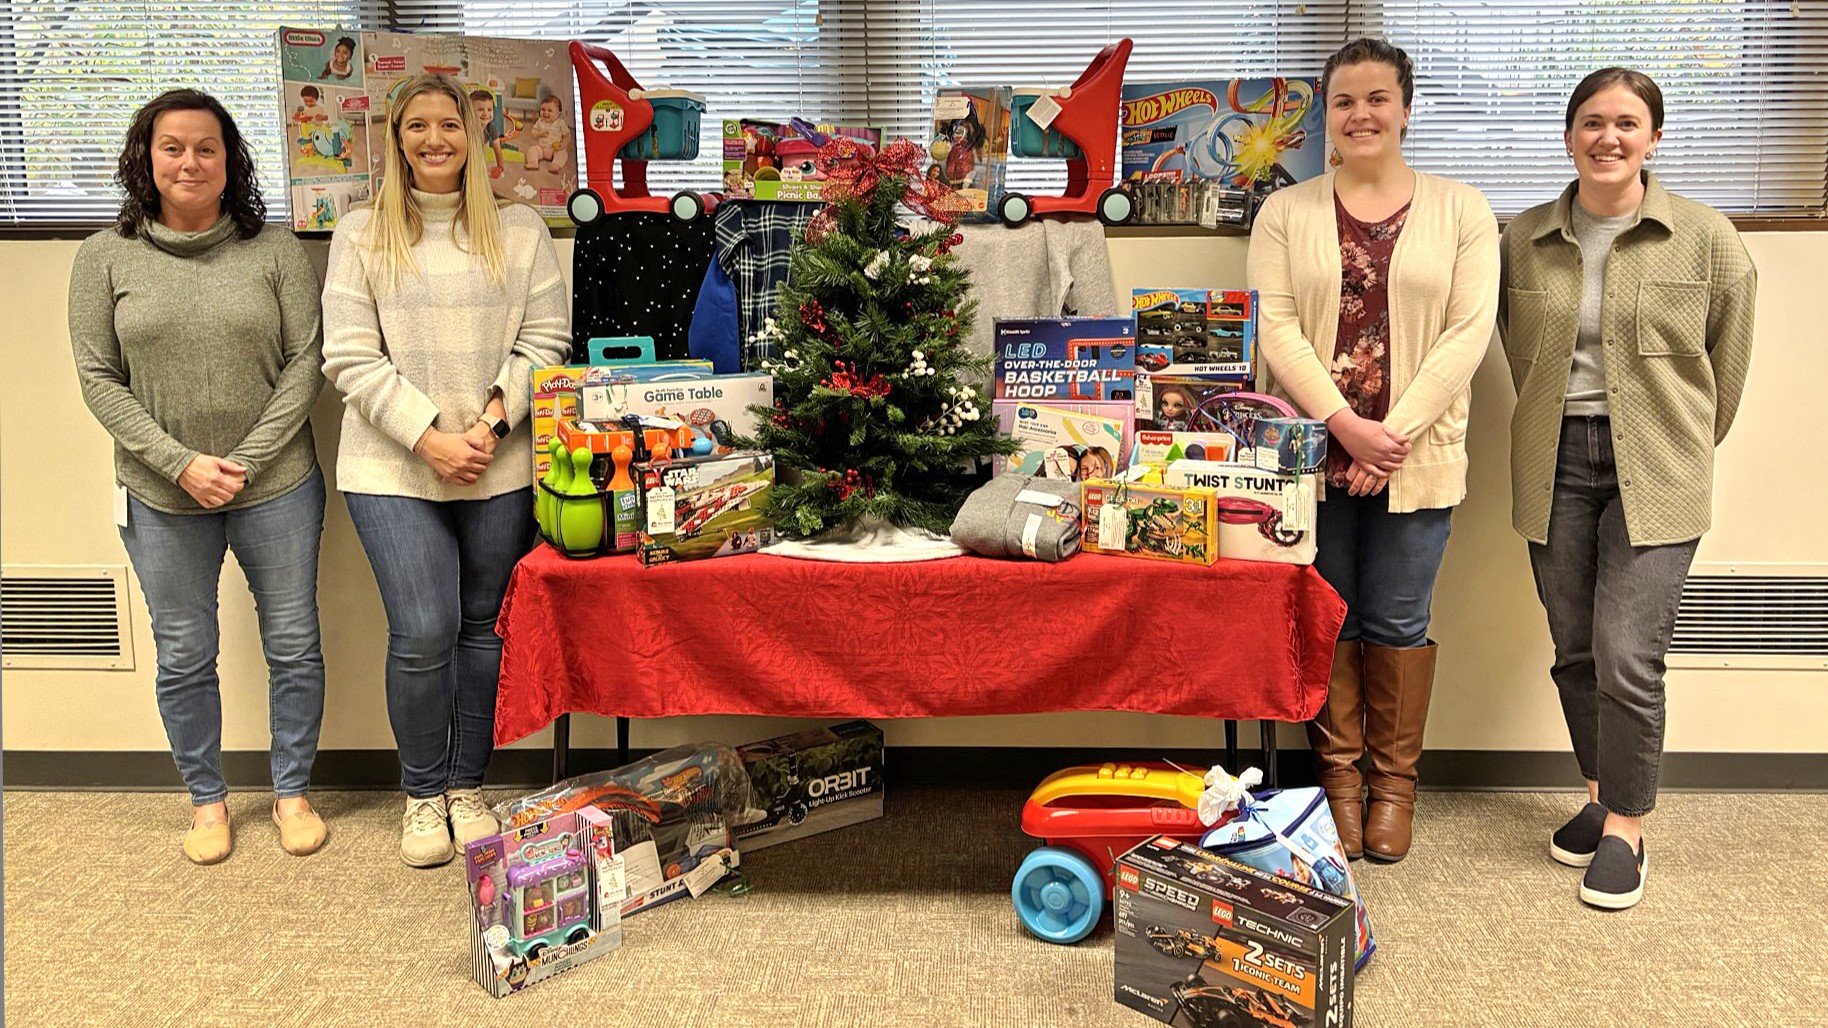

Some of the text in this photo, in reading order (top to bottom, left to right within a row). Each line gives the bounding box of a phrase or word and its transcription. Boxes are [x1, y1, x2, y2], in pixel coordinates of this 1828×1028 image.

[1125, 89, 1212, 125] HOT WHEELS
[1153, 131, 1173, 139] NETFLIX
[777, 190, 803, 200] Picnic
[1134, 291, 1178, 309] HOT WHEELS
[1004, 342, 1047, 359] LED
[1004, 359, 1097, 370] OVER-THE-DOOR
[1004, 369, 1122, 384] BASKETBALL
[541, 377, 577, 393] PLAY-DO
[1004, 385, 1057, 398] HOOP
[643, 389, 685, 403] Game
[687, 386, 723, 400] Table
[667, 467, 699, 477] STAR
[645, 476, 659, 486] LEG
[663, 475, 700, 487] WARS
[1184, 473, 1230, 489] TWIST
[1088, 492, 1139, 505] LEGO CREAOR
[808, 766, 872, 798] ORBIT
[808, 786, 872, 808] Light-Up Kick Scooter
[650, 882, 675, 899] STUNT
[1119, 889, 1130, 899] 9+
[1121, 871, 1139, 885] LEGO
[1144, 877, 1200, 907] SPEED
[1213, 905, 1304, 948] LEGO TECHNIC
[1243, 940, 1305, 979] 2 SETS
[1232, 958, 1301, 994] 1 ICONIC TEAM
[1325, 961, 1338, 1028] 2 SETS
